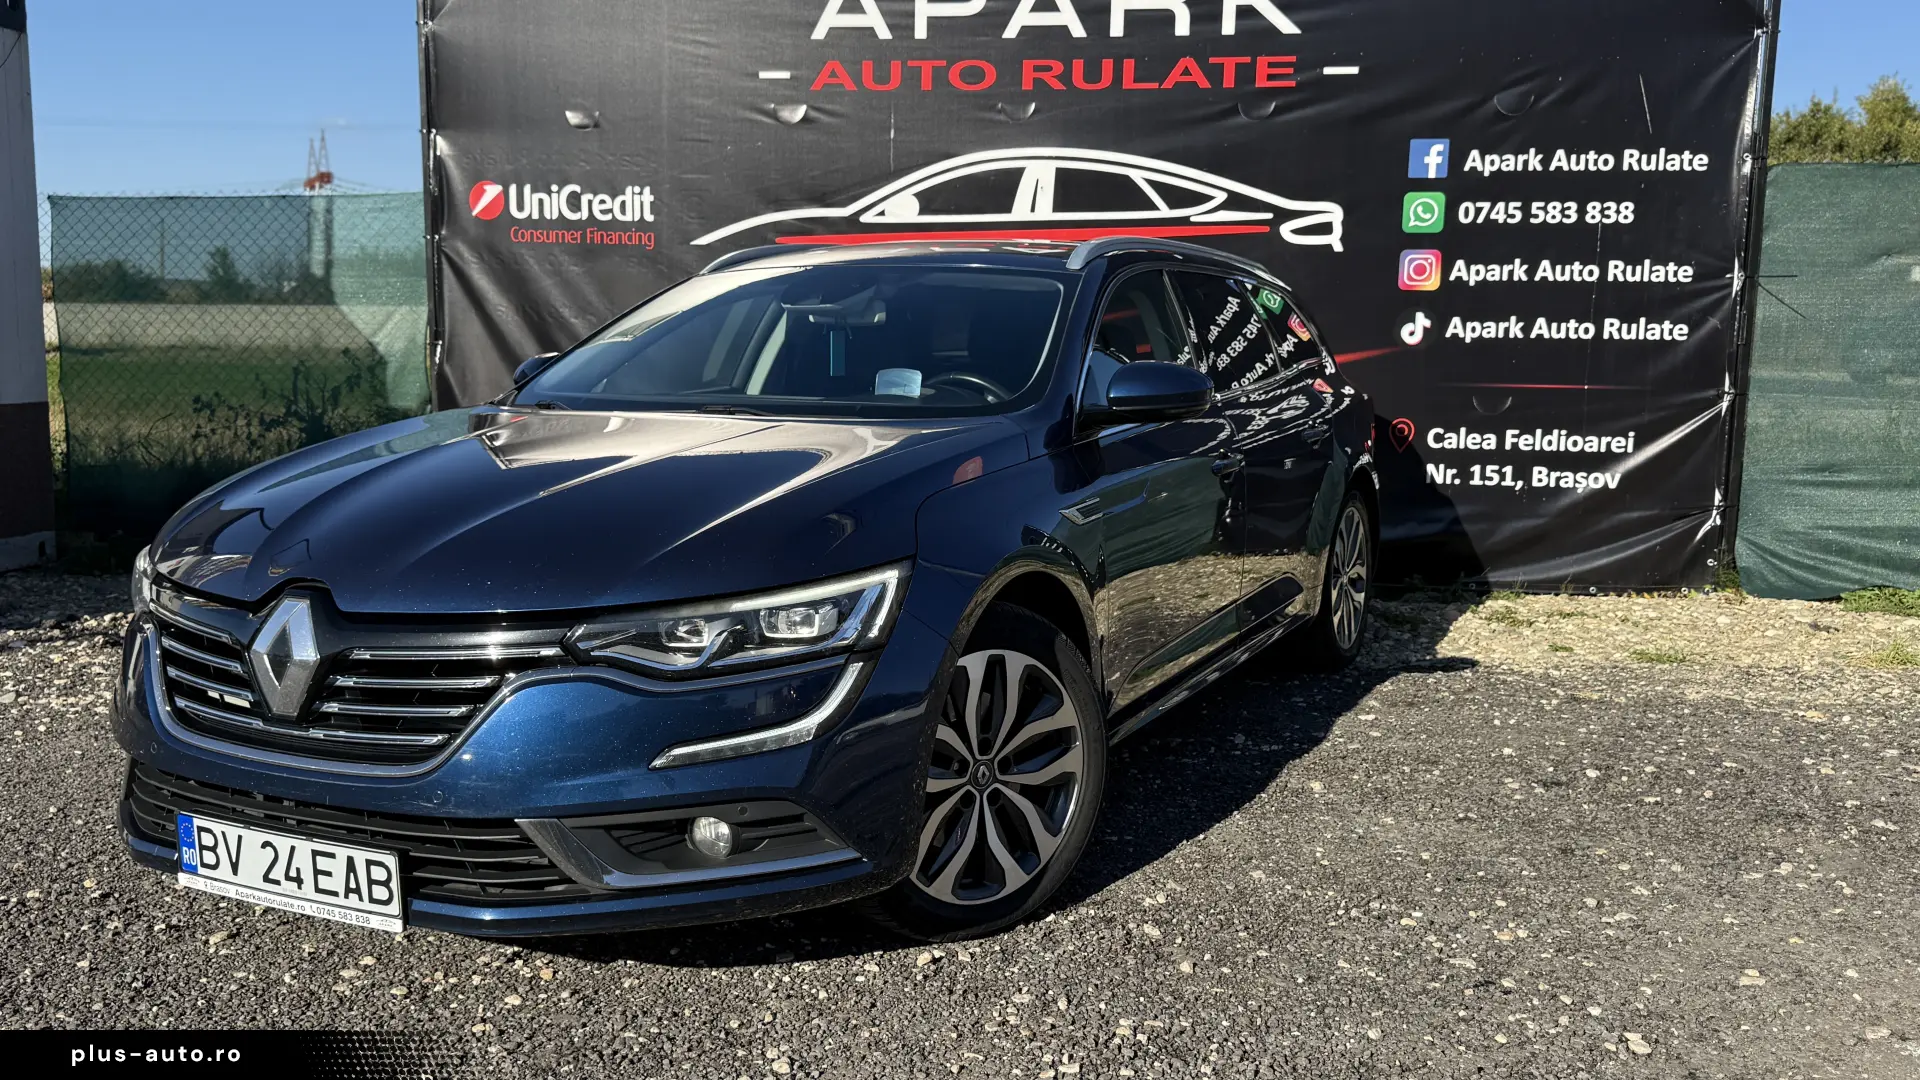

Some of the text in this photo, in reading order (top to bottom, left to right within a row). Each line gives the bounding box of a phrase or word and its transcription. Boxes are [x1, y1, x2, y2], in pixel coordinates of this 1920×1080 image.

[810, 56, 1298, 91] AUTO RULATE
[1464, 148, 1709, 176] Apark Auto Rulate
[508, 183, 655, 222] UniCredit
[1458, 202, 1635, 224] 0745 583 838
[510, 226, 655, 251] Consumer Financing
[1449, 258, 1694, 286] Apark Auto Rulate
[1444, 316, 1689, 344] Apark Auto Rulate
[1427, 427, 1636, 453] Calea Feldioarei
[1426, 463, 1622, 493] Nr. 151, Brașov
[183, 846, 197, 866] RO
[197, 824, 243, 877] BV
[235, 889, 306, 912] Aparkautorulate.ro
[316, 906, 337, 918] 0745
[338, 911, 354, 922] 583
[355, 914, 371, 925] 838
